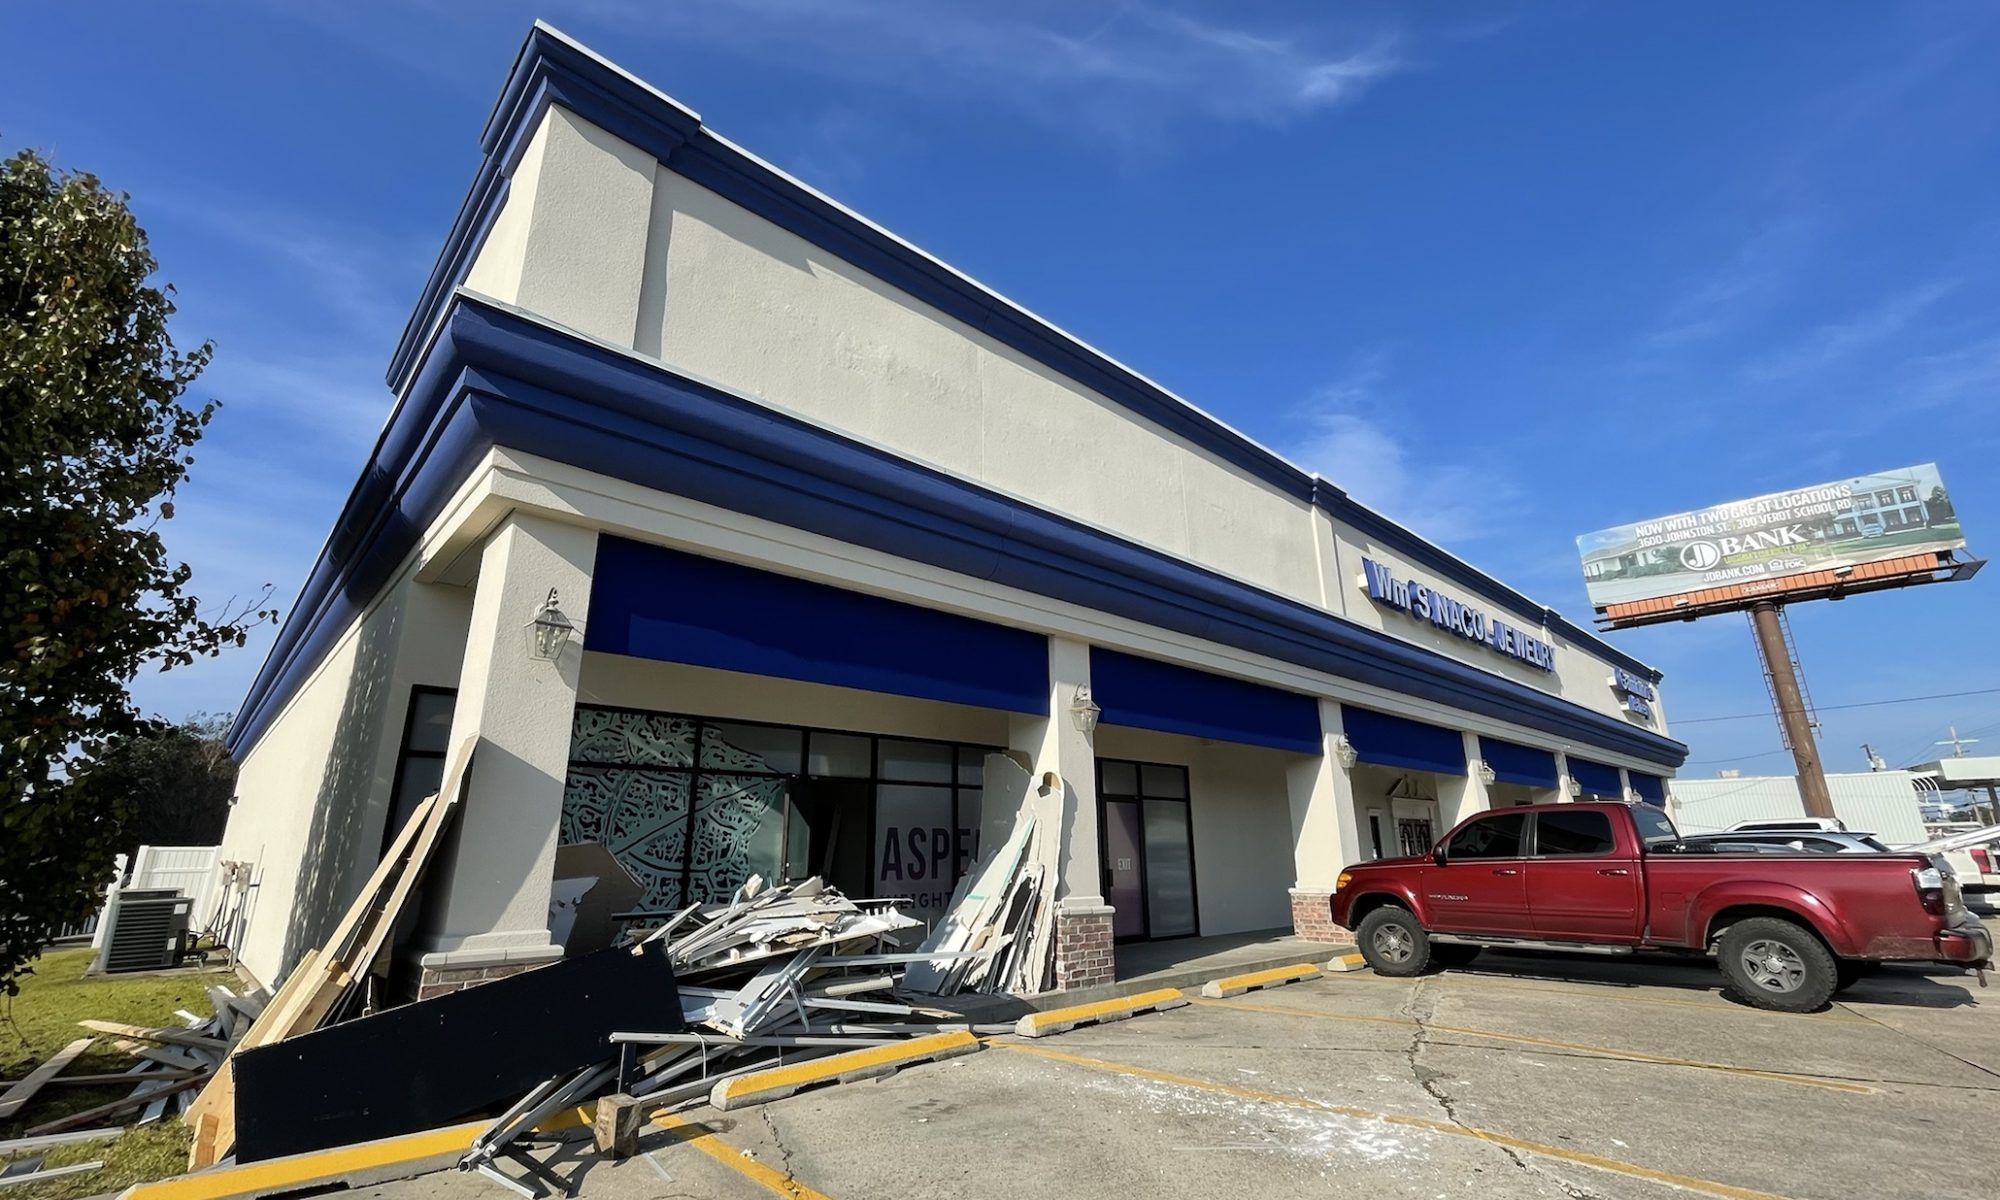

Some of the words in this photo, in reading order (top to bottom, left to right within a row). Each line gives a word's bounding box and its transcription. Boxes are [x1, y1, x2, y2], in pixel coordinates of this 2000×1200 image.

[1635, 521, 1663, 538] NOW
[1664, 513, 1698, 532] WITH
[1698, 508, 1729, 524] TWO
[1730, 499, 1772, 519] GREAT
[1773, 484, 1852, 510] LOCATIONS
[1637, 535, 1662, 549] 3600
[1663, 525, 1715, 543] JOHNSTON
[1758, 509, 1793, 525] VEROT
[1793, 501, 1836, 519] SCHOOL
[1718, 523, 1810, 557] BANK
[1703, 563, 1766, 582] JDBANK.COM
[1361, 556, 1412, 610] Wm
[1429, 590, 1495, 645] NACOL
[1492, 619, 1557, 672] JEWELRY
[880, 826, 981, 881] ASPE
[1117, 857, 1131, 871] EXIT
